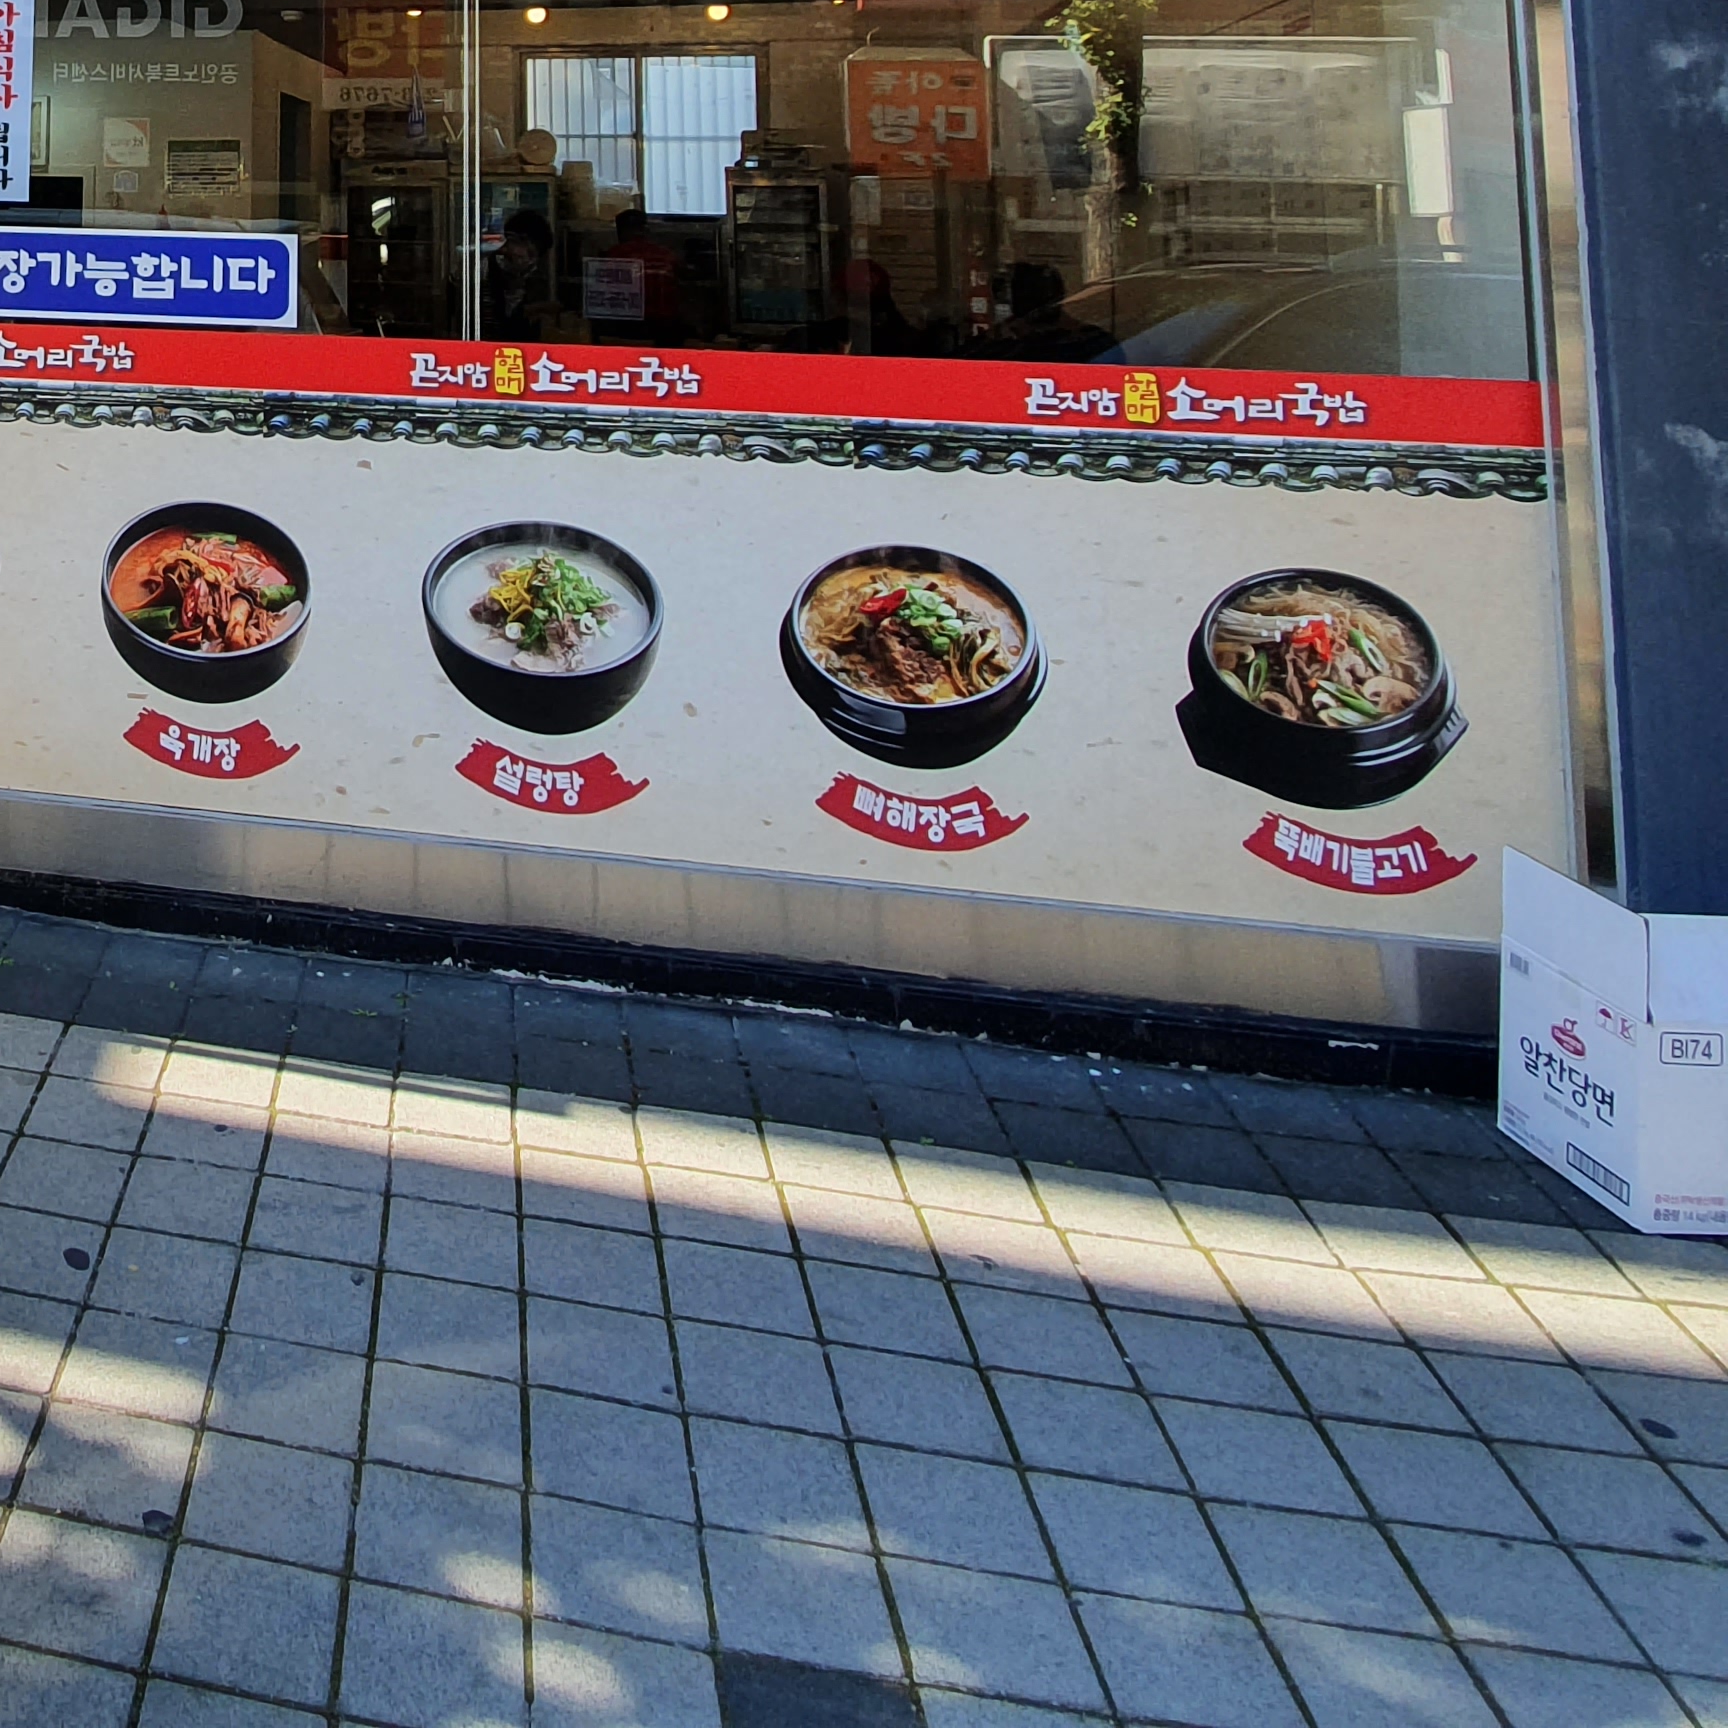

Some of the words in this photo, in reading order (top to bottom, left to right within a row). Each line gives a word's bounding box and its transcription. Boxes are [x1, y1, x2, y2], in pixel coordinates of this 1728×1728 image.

[409, 352, 492, 390] 곤지암
[529, 350, 701, 398] 소머리국밥
[1024, 377, 1117, 419] 곤지암
[1166, 375, 1368, 427] 소머리국밥
[158, 723, 242, 773] 육개장
[1519, 1035, 1616, 1128] 알찬당면
